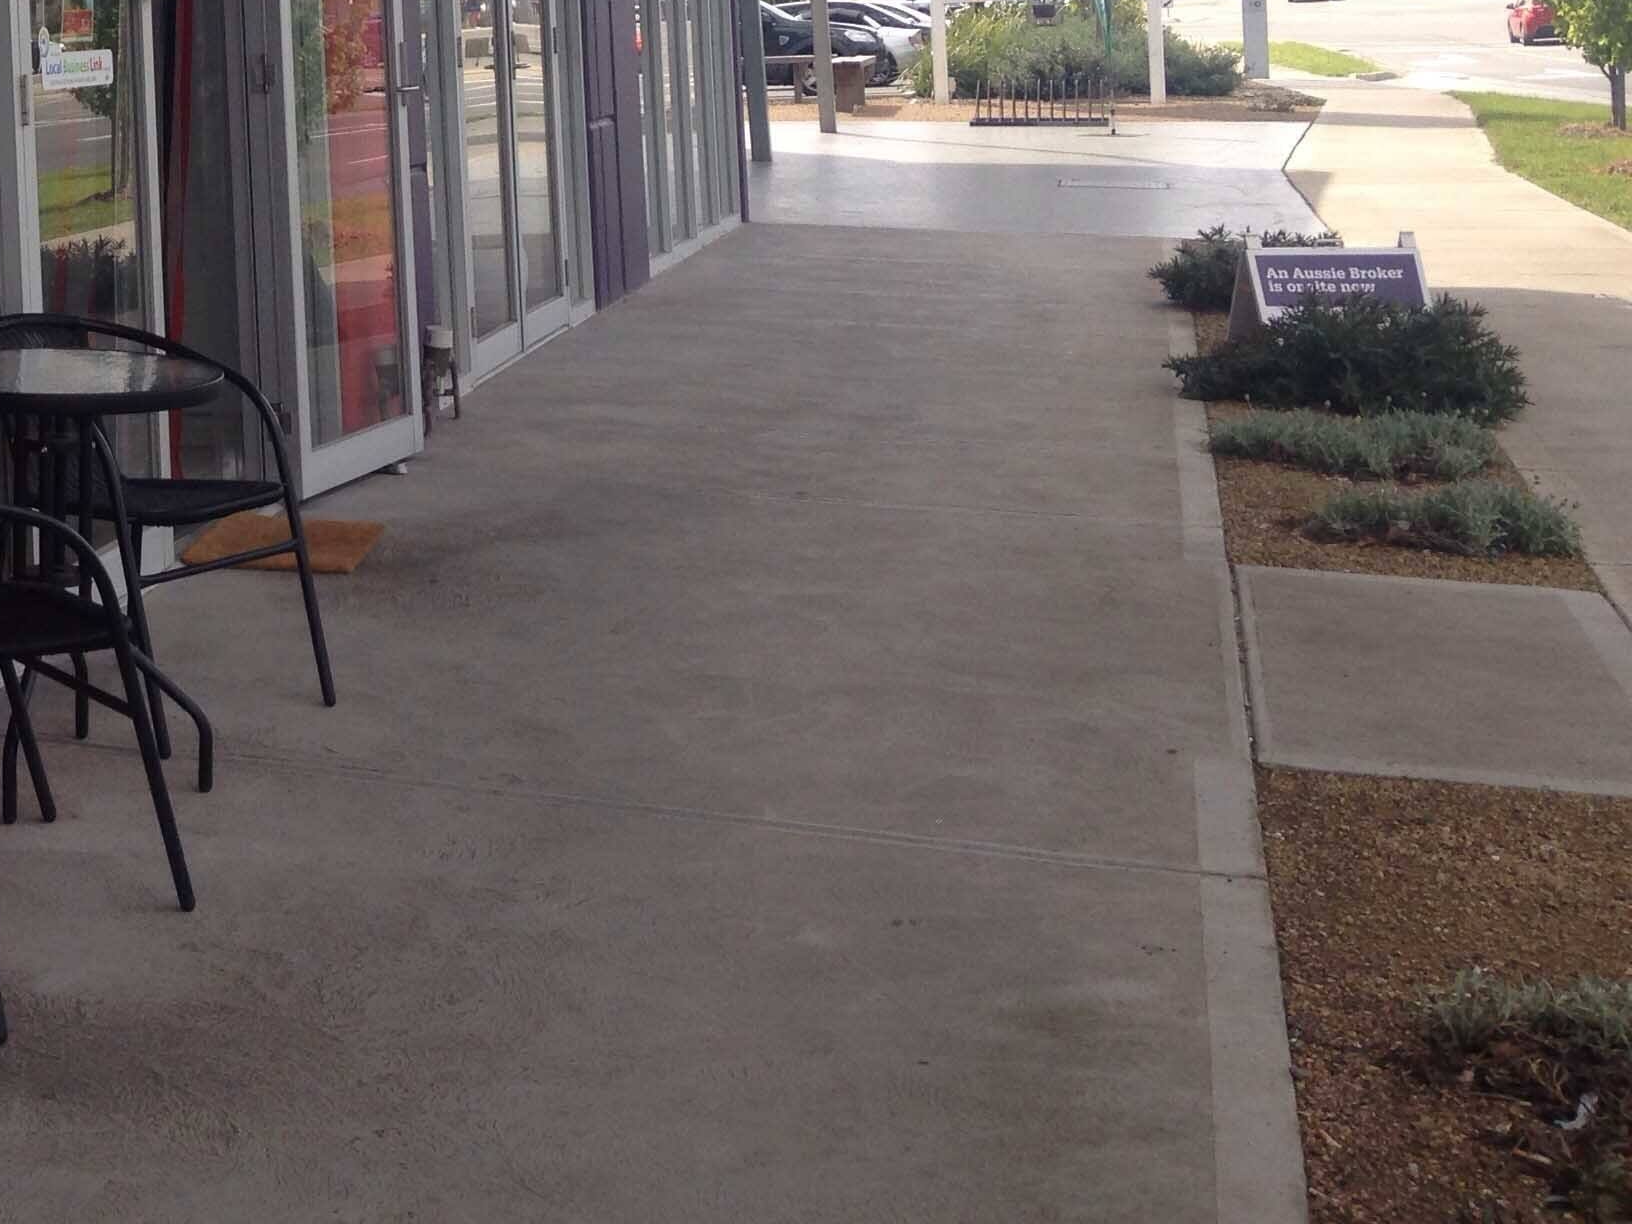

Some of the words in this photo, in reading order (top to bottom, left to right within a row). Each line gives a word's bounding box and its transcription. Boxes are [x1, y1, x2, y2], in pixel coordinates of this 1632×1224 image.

[1267, 267, 1289, 279] An
[1293, 267, 1346, 279] Aussie
[1349, 266, 1404, 279] Broker
[1269, 280, 1283, 292] is
